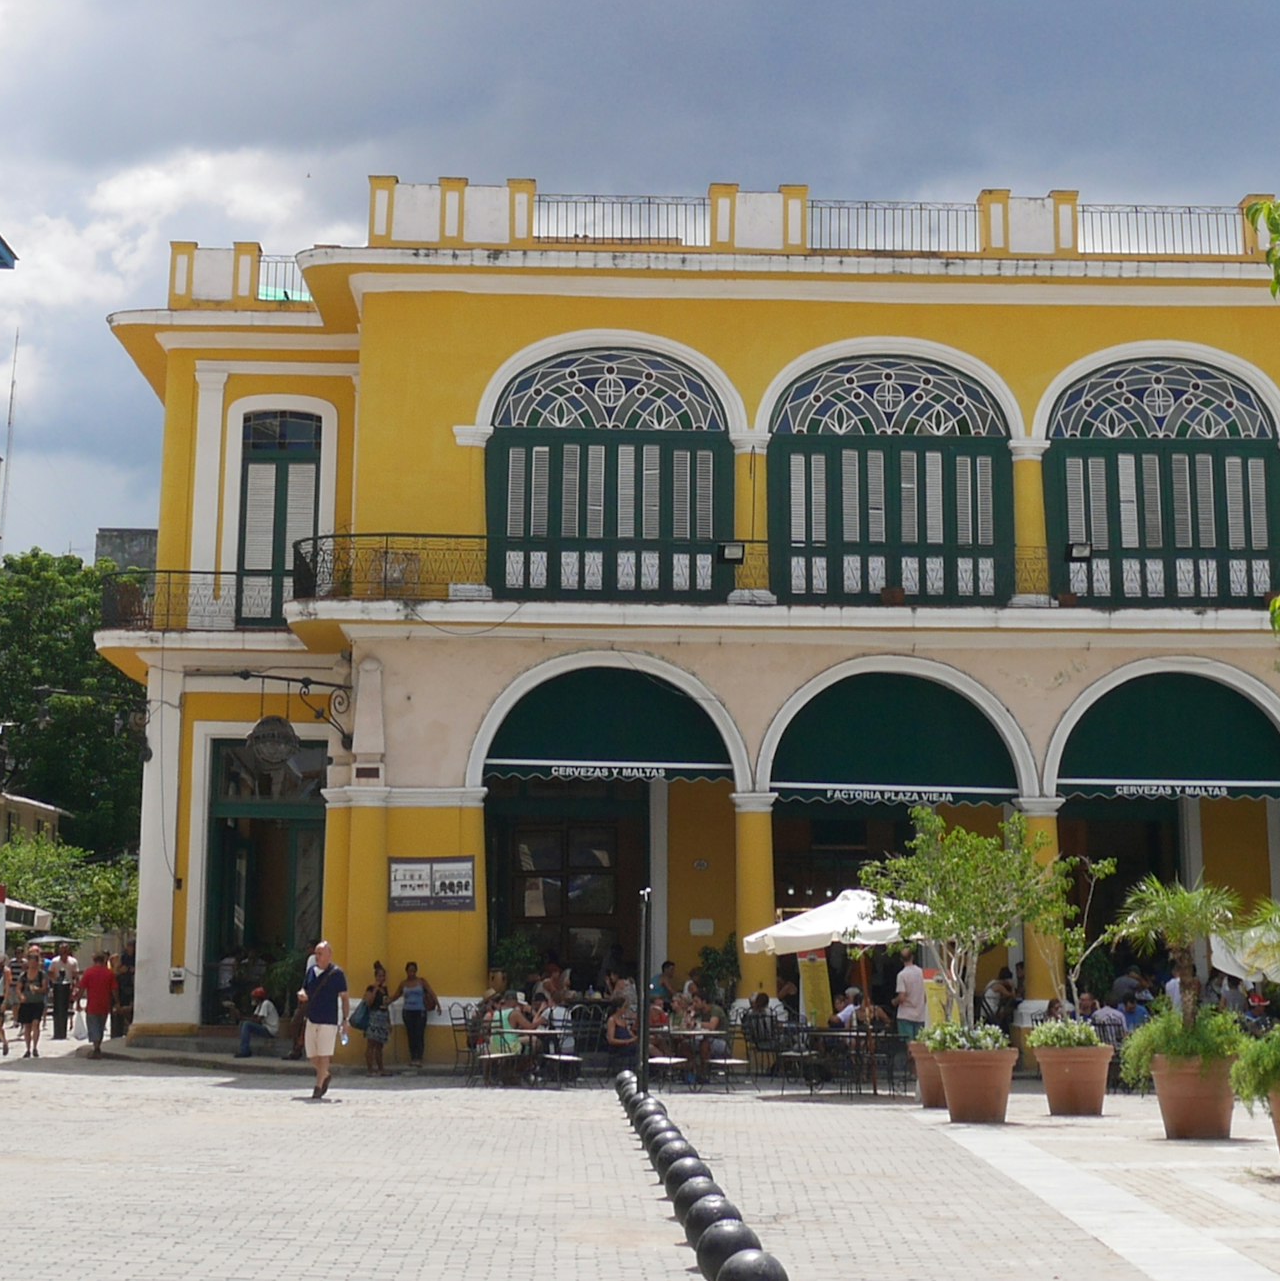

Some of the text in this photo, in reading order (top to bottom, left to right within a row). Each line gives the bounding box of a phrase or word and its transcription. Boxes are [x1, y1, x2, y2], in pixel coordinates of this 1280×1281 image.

[551, 766, 666, 777] CERVEZAS Y MALTAS
[826, 789, 953, 802] FACTORIA PLAZA VIEJA
[1115, 785, 1228, 796] CERVEZAS Y MALTAS
